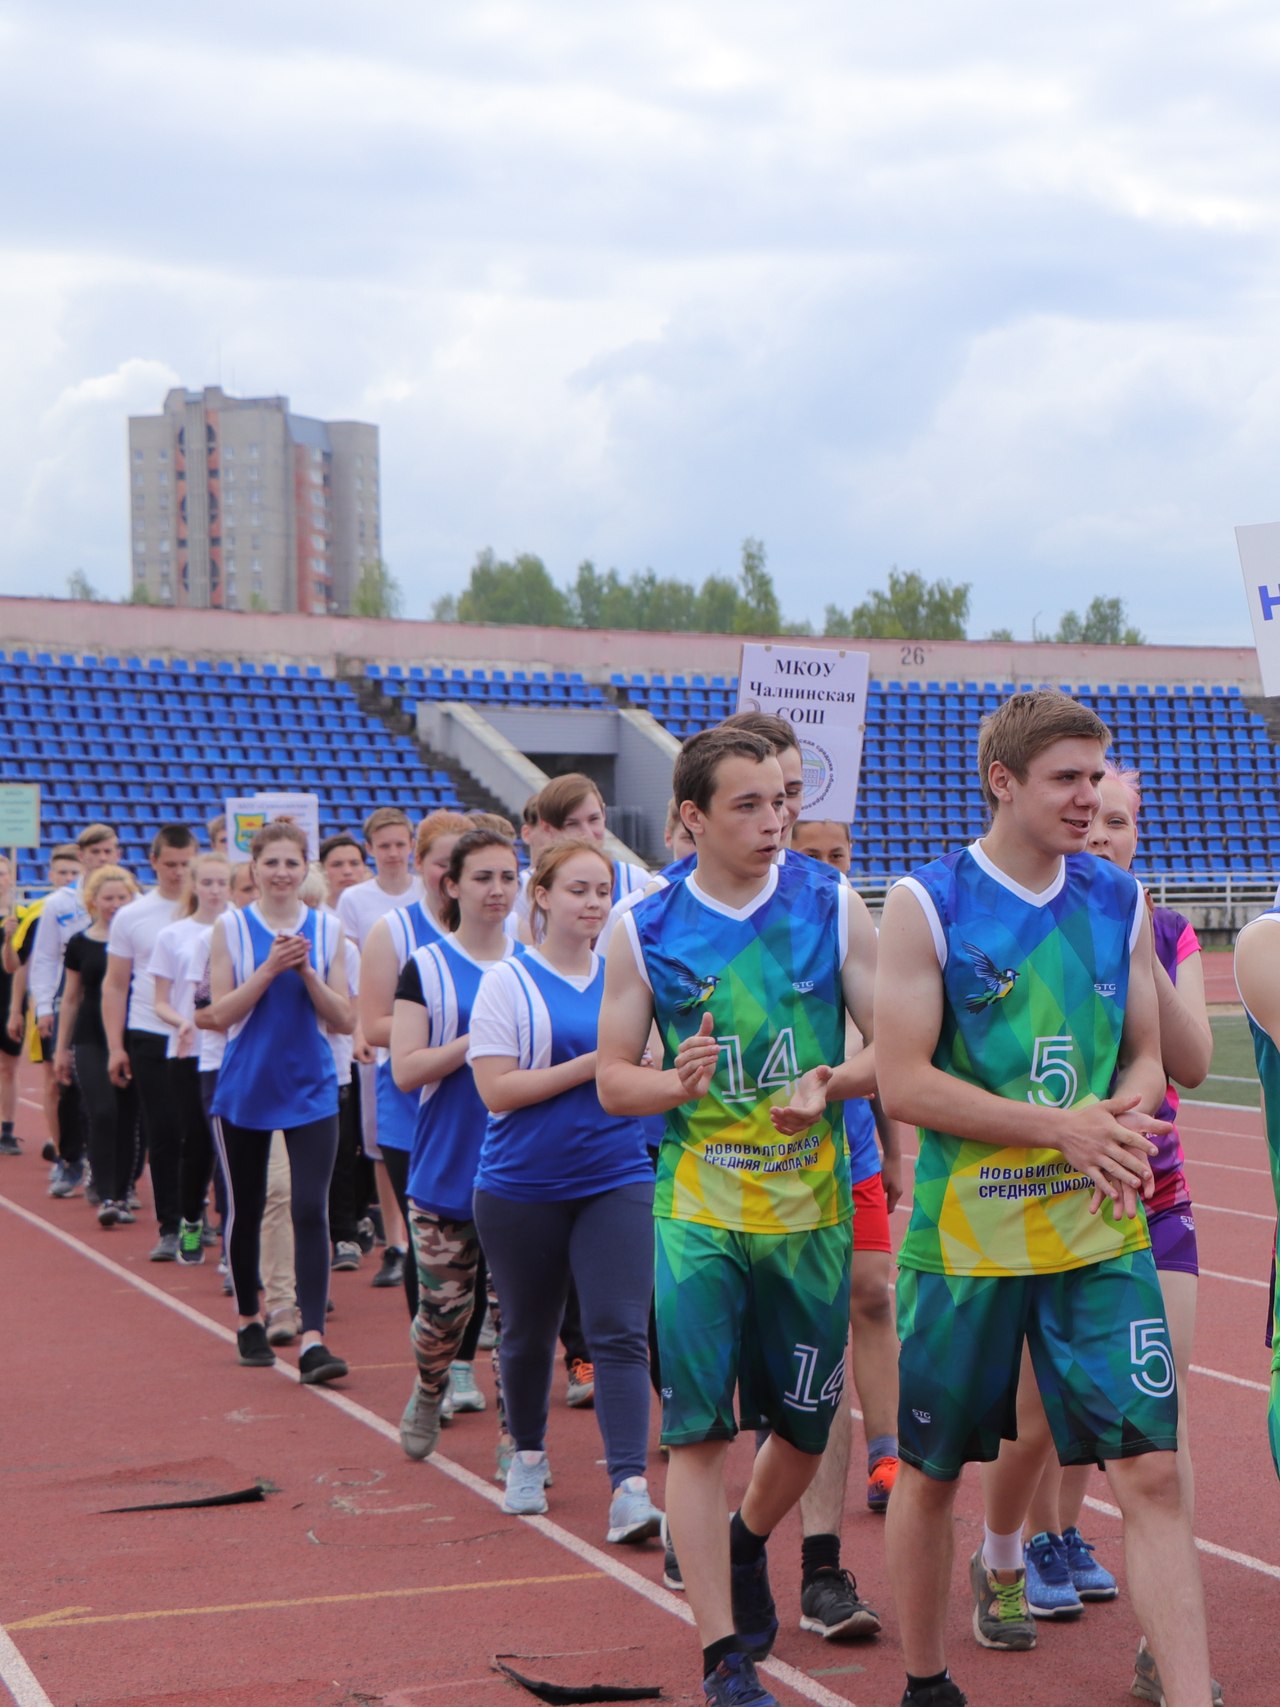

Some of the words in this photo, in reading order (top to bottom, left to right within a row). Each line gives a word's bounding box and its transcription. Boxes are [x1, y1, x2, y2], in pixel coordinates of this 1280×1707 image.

[900, 646, 925, 665] 26
[774, 659, 836, 678] МКОУ
[750, 681, 856, 703] Чалнинская
[1094, 983, 1116, 991] STG
[717, 1027, 803, 1103] 14
[1027, 1035, 1078, 1110] 5
[704, 1154, 760, 1171] СРЕДНЯЯ
[763, 1159, 802, 1172] ШКОЛА
[979, 1183, 1046, 1199] СРЕДНЯЯ
[1130, 1318, 1175, 1398] 5
